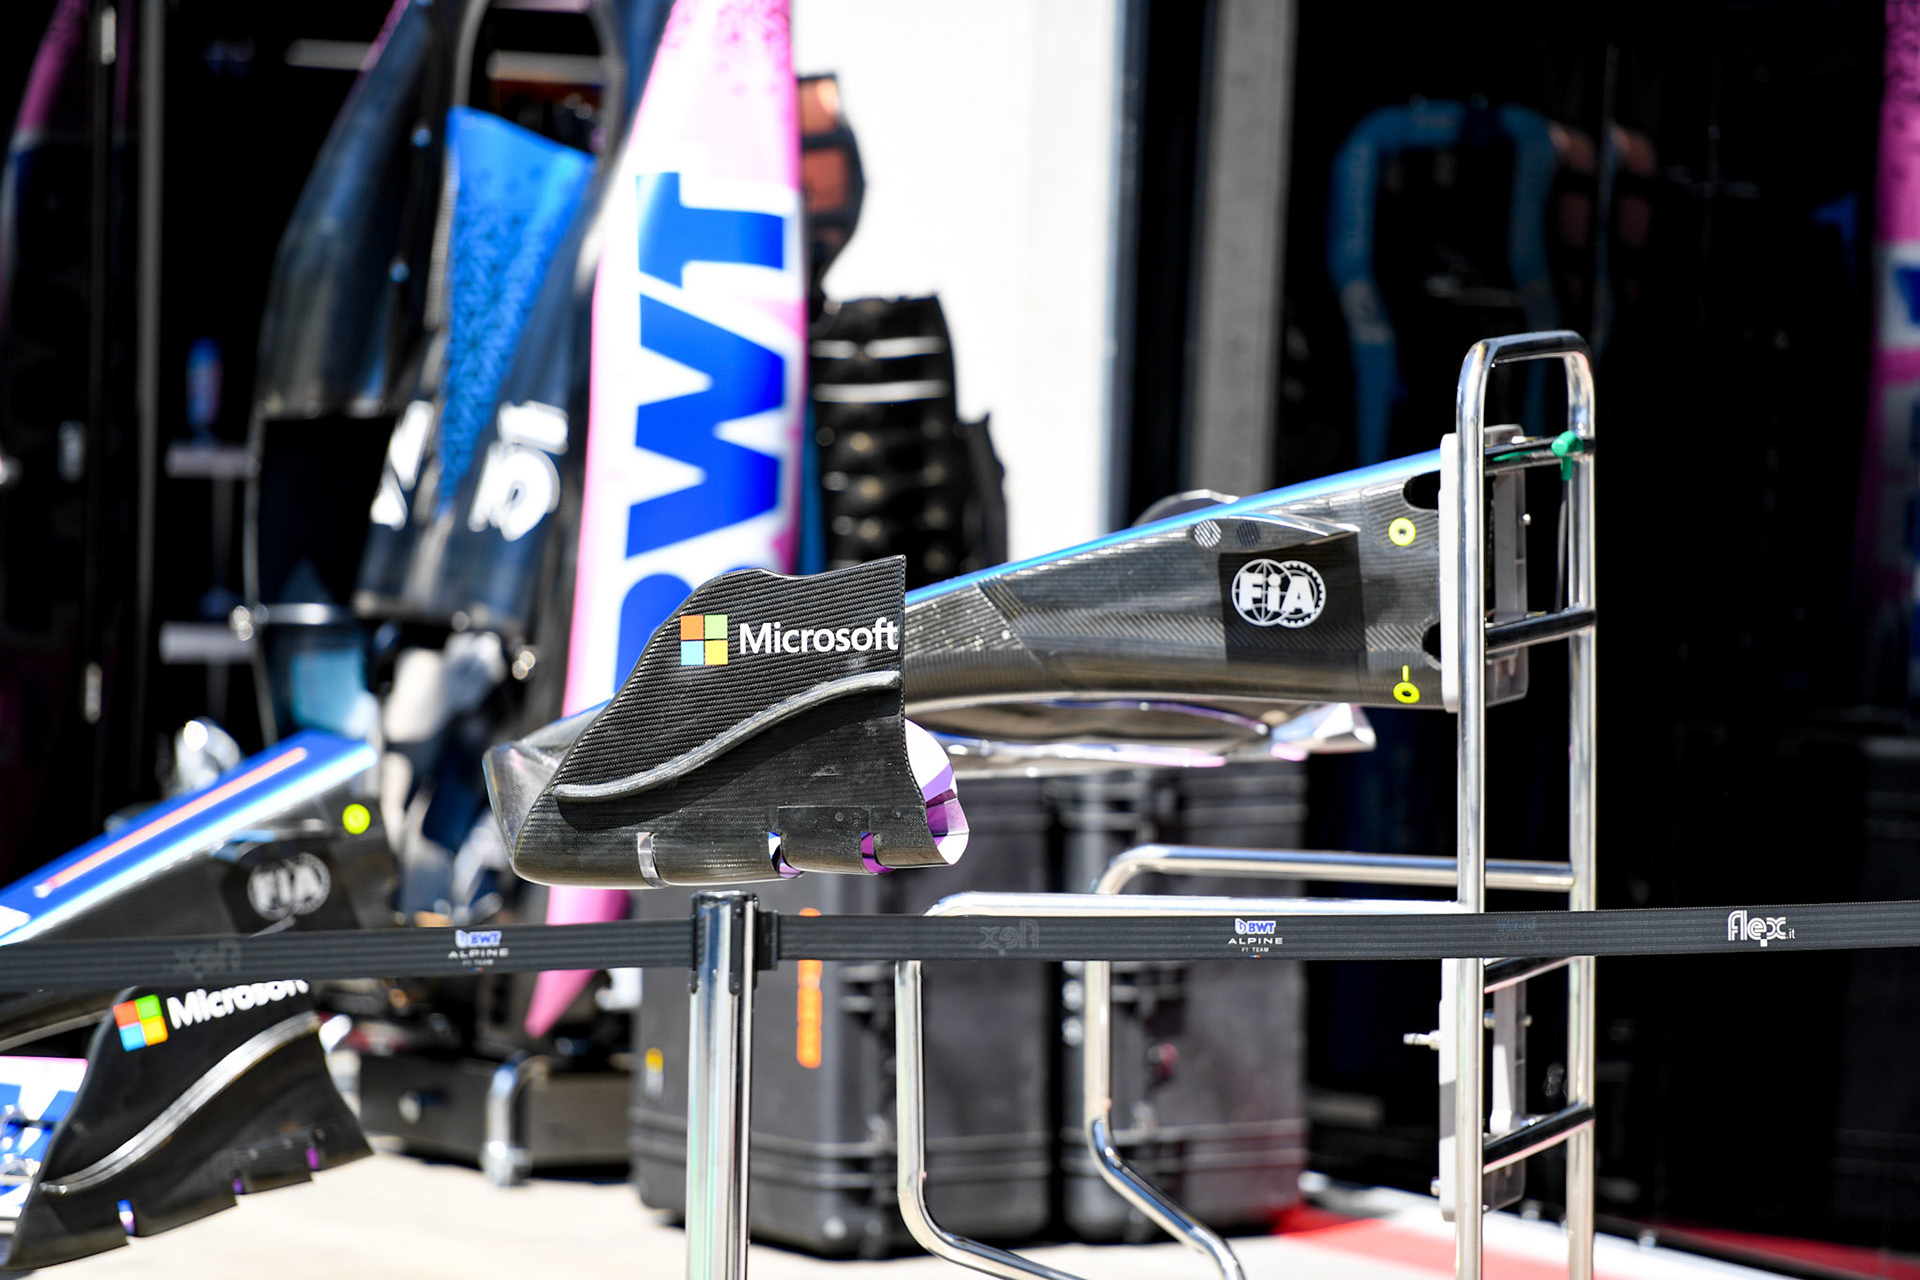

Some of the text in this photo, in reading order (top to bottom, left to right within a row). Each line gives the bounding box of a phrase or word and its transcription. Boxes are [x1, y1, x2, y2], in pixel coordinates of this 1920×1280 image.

[738, 616, 900, 656] Microsoft
[1245, 920, 1277, 935] BWT
[1227, 937, 1284, 945] ALPINE
